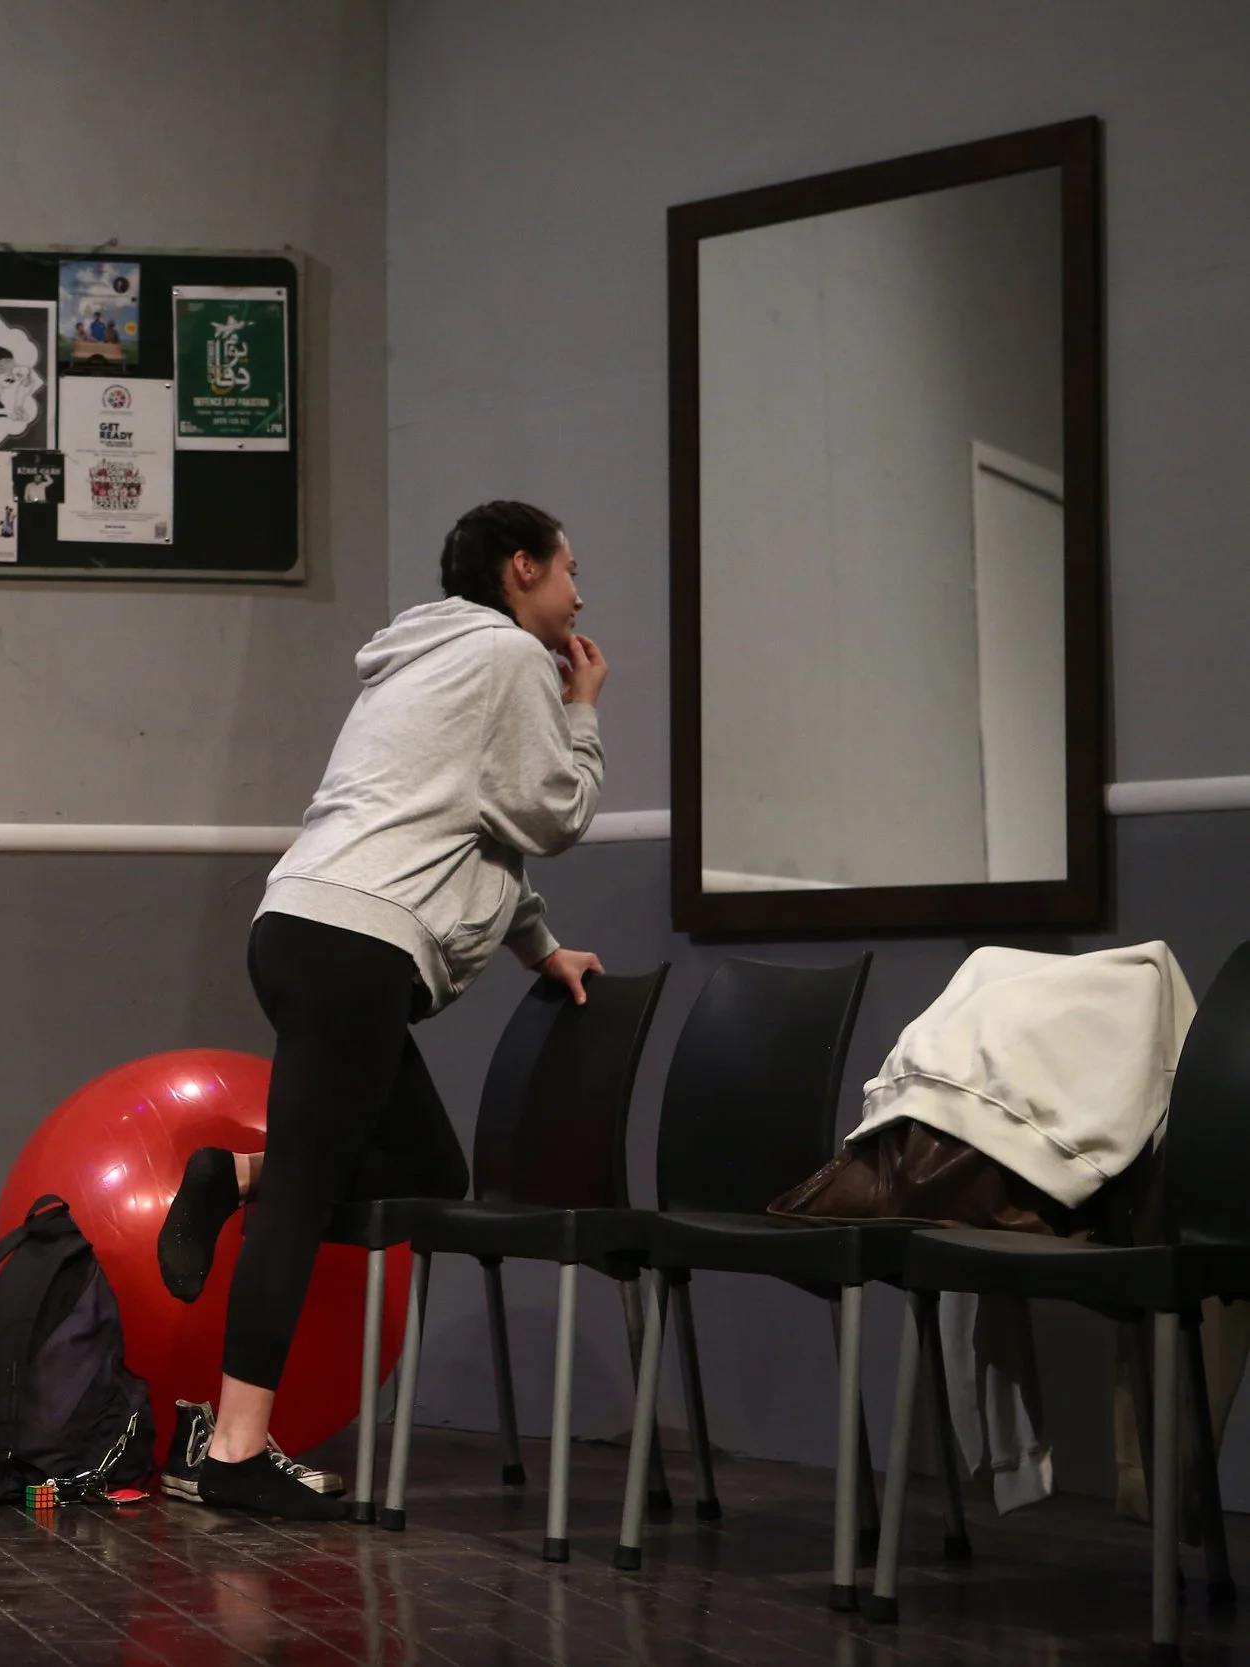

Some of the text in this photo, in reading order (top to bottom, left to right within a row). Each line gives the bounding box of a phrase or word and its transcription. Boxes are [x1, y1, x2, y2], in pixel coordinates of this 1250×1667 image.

[193, 397, 222, 406] DEFENCE
[224, 397, 237, 407] DAY
[100, 423, 120, 431] GET
[100, 431, 133, 440] READY
